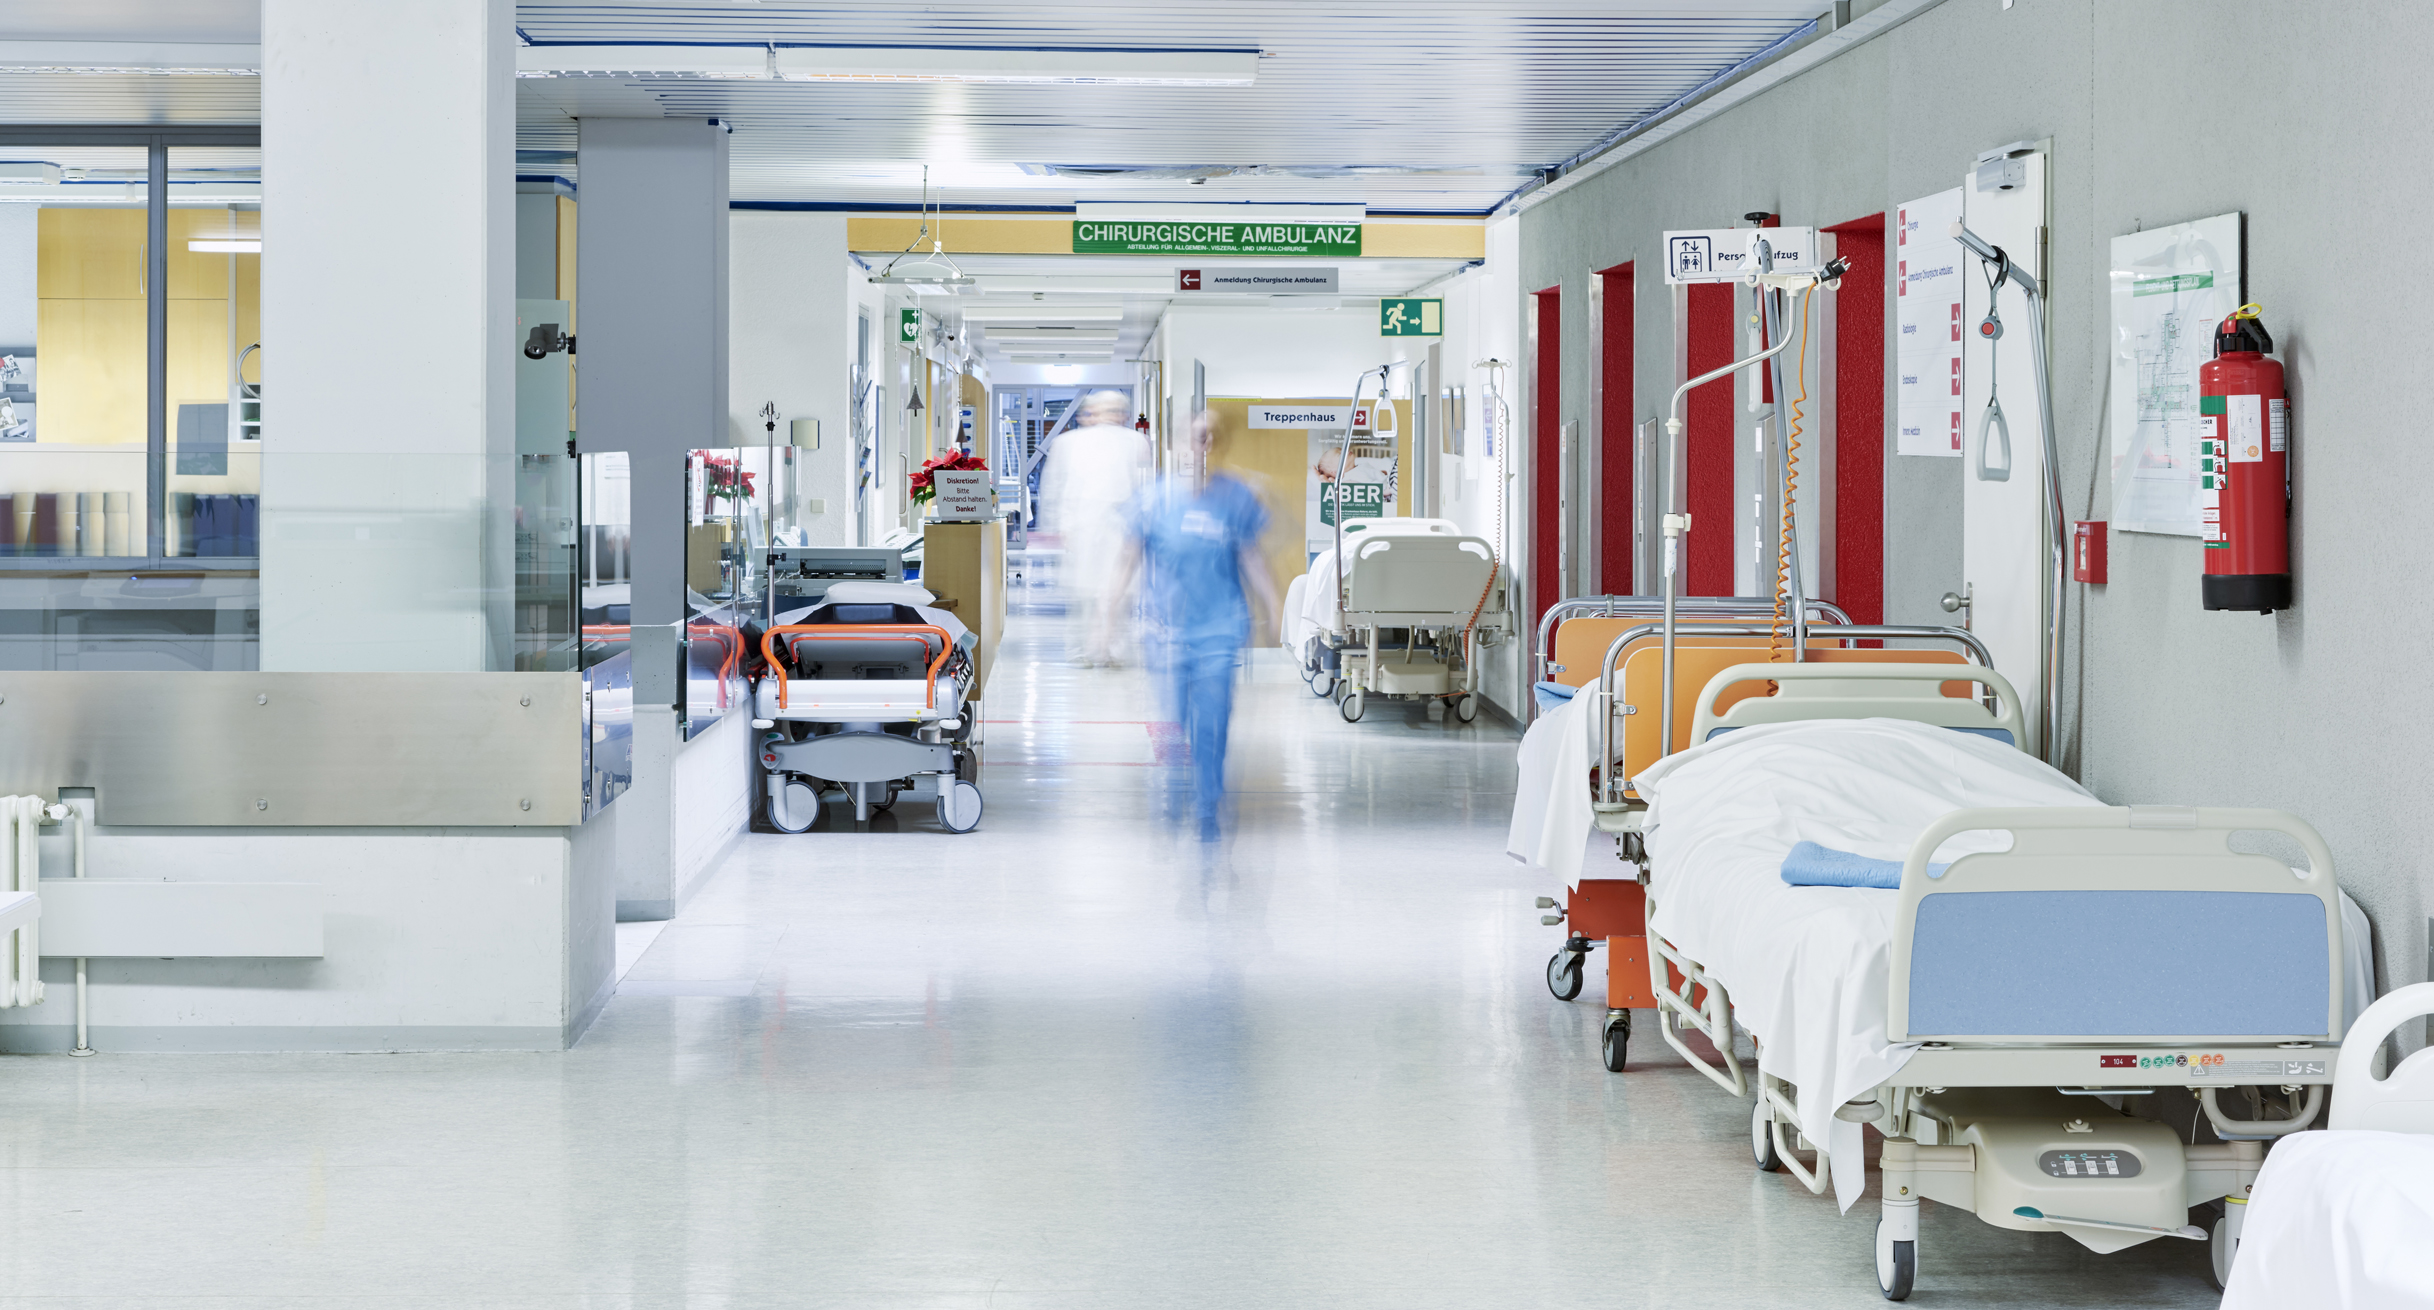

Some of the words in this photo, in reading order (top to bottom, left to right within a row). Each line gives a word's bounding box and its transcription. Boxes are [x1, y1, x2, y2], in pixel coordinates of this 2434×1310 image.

[1078, 223, 1234, 243] CHIRURGISCHE
[1240, 226, 1356, 244] AMBULANZ
[1127, 243, 1160, 251] ABTEILUNG
[1160, 243, 1173, 251] FÜR
[1213, 277, 1252, 285] Anmeldung
[1252, 276, 1293, 285] Chirurgische
[1293, 276, 1327, 284] Ambulanz
[1264, 412, 1336, 424] Treppenhaus
[1322, 485, 1380, 503] ABER
[2113, 1058, 2124, 1066] 104
